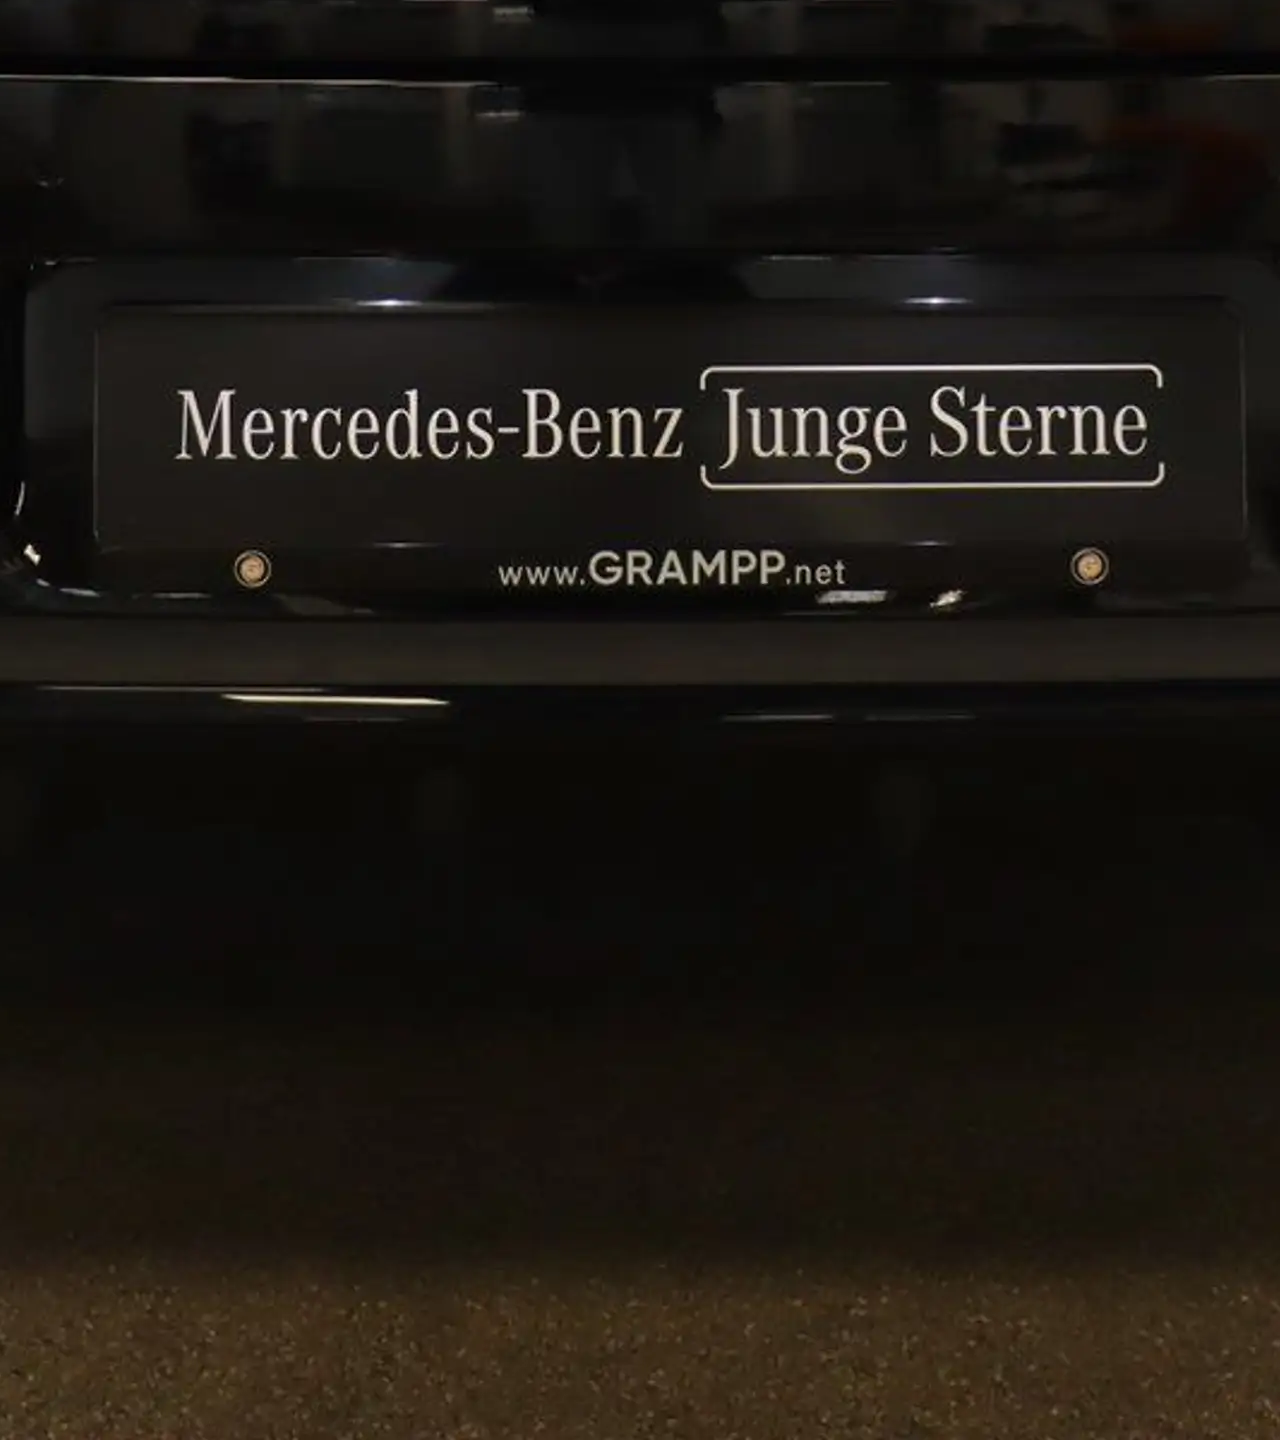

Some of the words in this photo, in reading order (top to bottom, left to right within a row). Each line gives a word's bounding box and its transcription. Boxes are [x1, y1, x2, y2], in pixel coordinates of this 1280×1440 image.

[176, 388, 684, 461] Mercedes-Benz
[718, 387, 908, 475] Junge
[930, 386, 1148, 458] Sterne
[498, 548, 847, 587] www.GRAMPP.net
